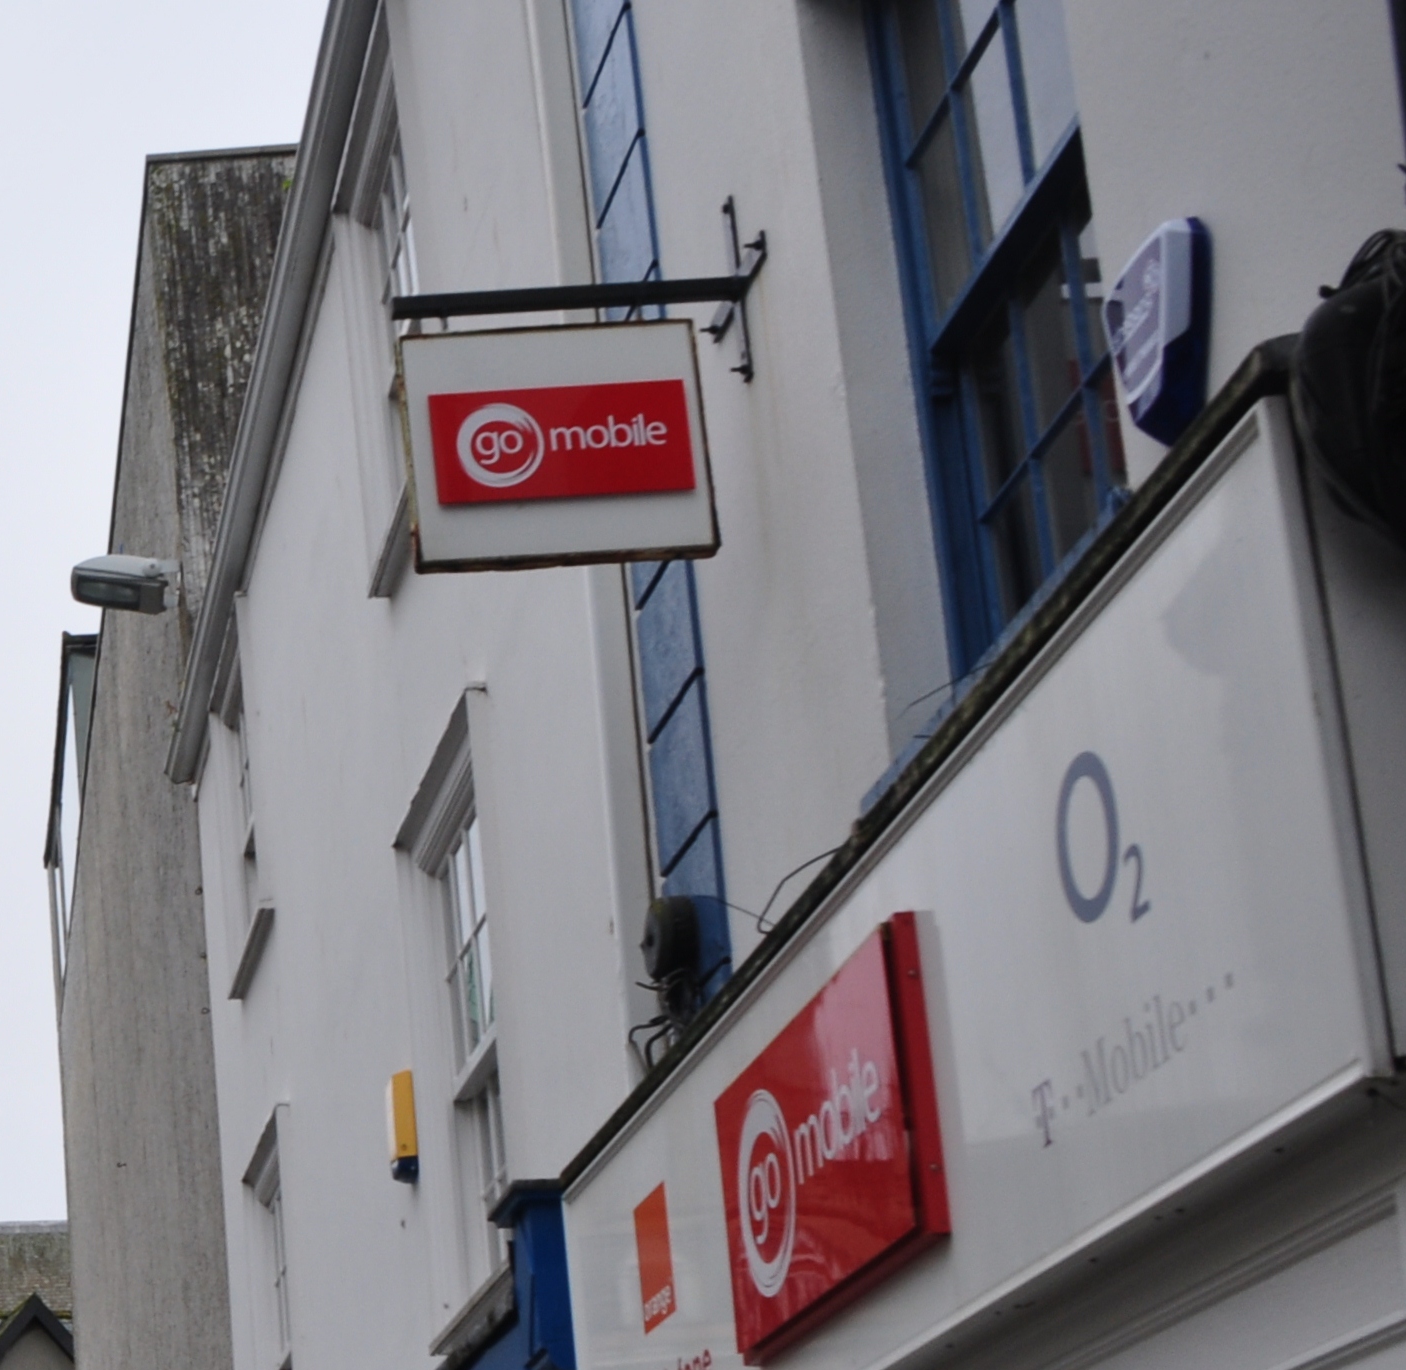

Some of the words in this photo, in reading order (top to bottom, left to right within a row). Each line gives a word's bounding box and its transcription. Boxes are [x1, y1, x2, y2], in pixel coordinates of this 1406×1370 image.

[475, 430, 524, 466] go
[549, 413, 668, 452] mobile
[748, 1153, 782, 1245] go
[793, 1049, 882, 1186] mobile
[643, 1284, 673, 1323] orange
